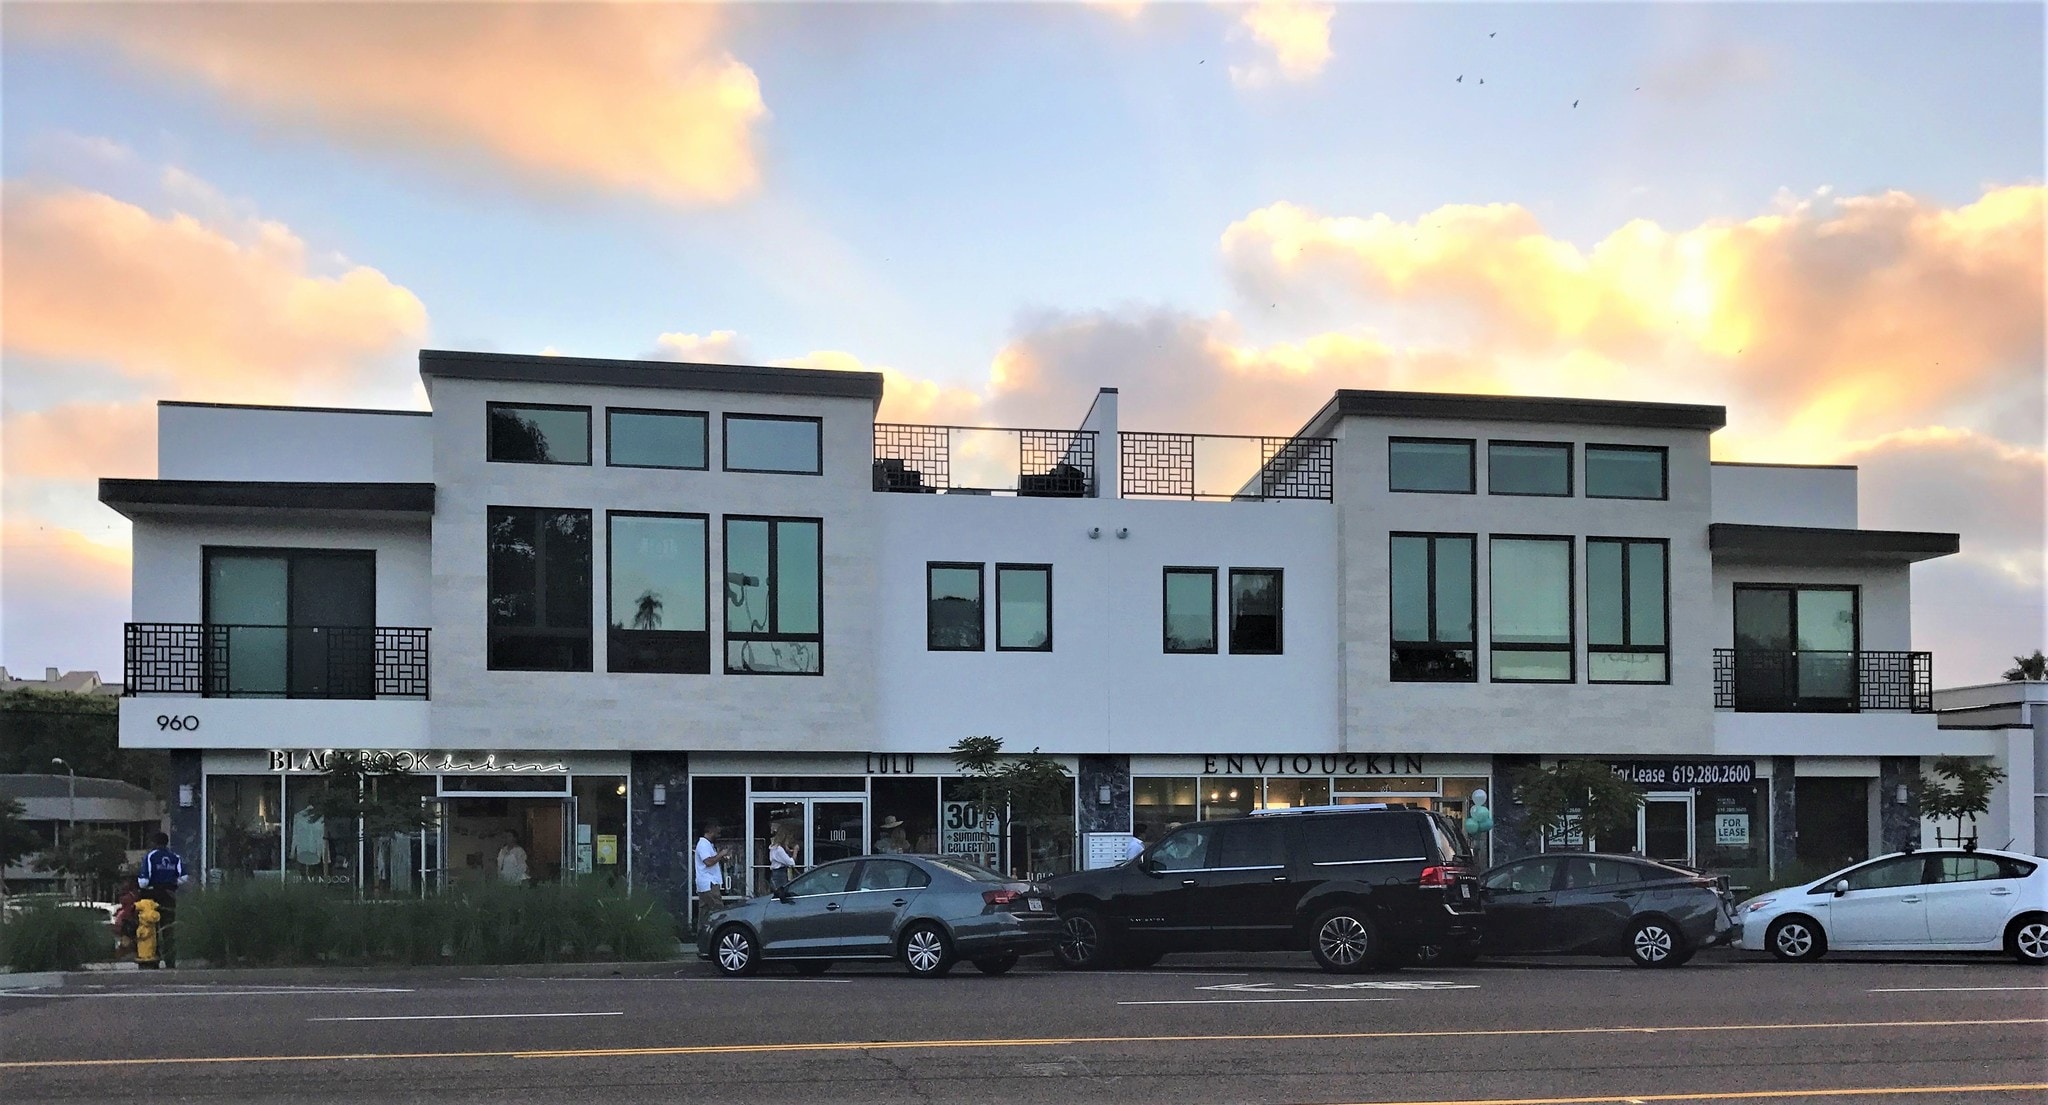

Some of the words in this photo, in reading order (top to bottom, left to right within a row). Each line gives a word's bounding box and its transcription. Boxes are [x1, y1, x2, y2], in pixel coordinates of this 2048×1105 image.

[157, 715, 200, 731] 960
[268, 749, 353, 771] BLAC
[360, 750, 430, 771] BOOK
[866, 753, 914, 774] LOLO
[1203, 755, 1424, 775] ENVIOUSKIN
[1610, 764, 1630, 782] For
[1632, 764, 1666, 783] Lease
[1672, 765, 1751, 783] 619.280.2600
[1722, 818, 1742, 828] FOR
[1551, 829, 1581, 838] LESE
[1718, 828, 1746, 837] LEASE
